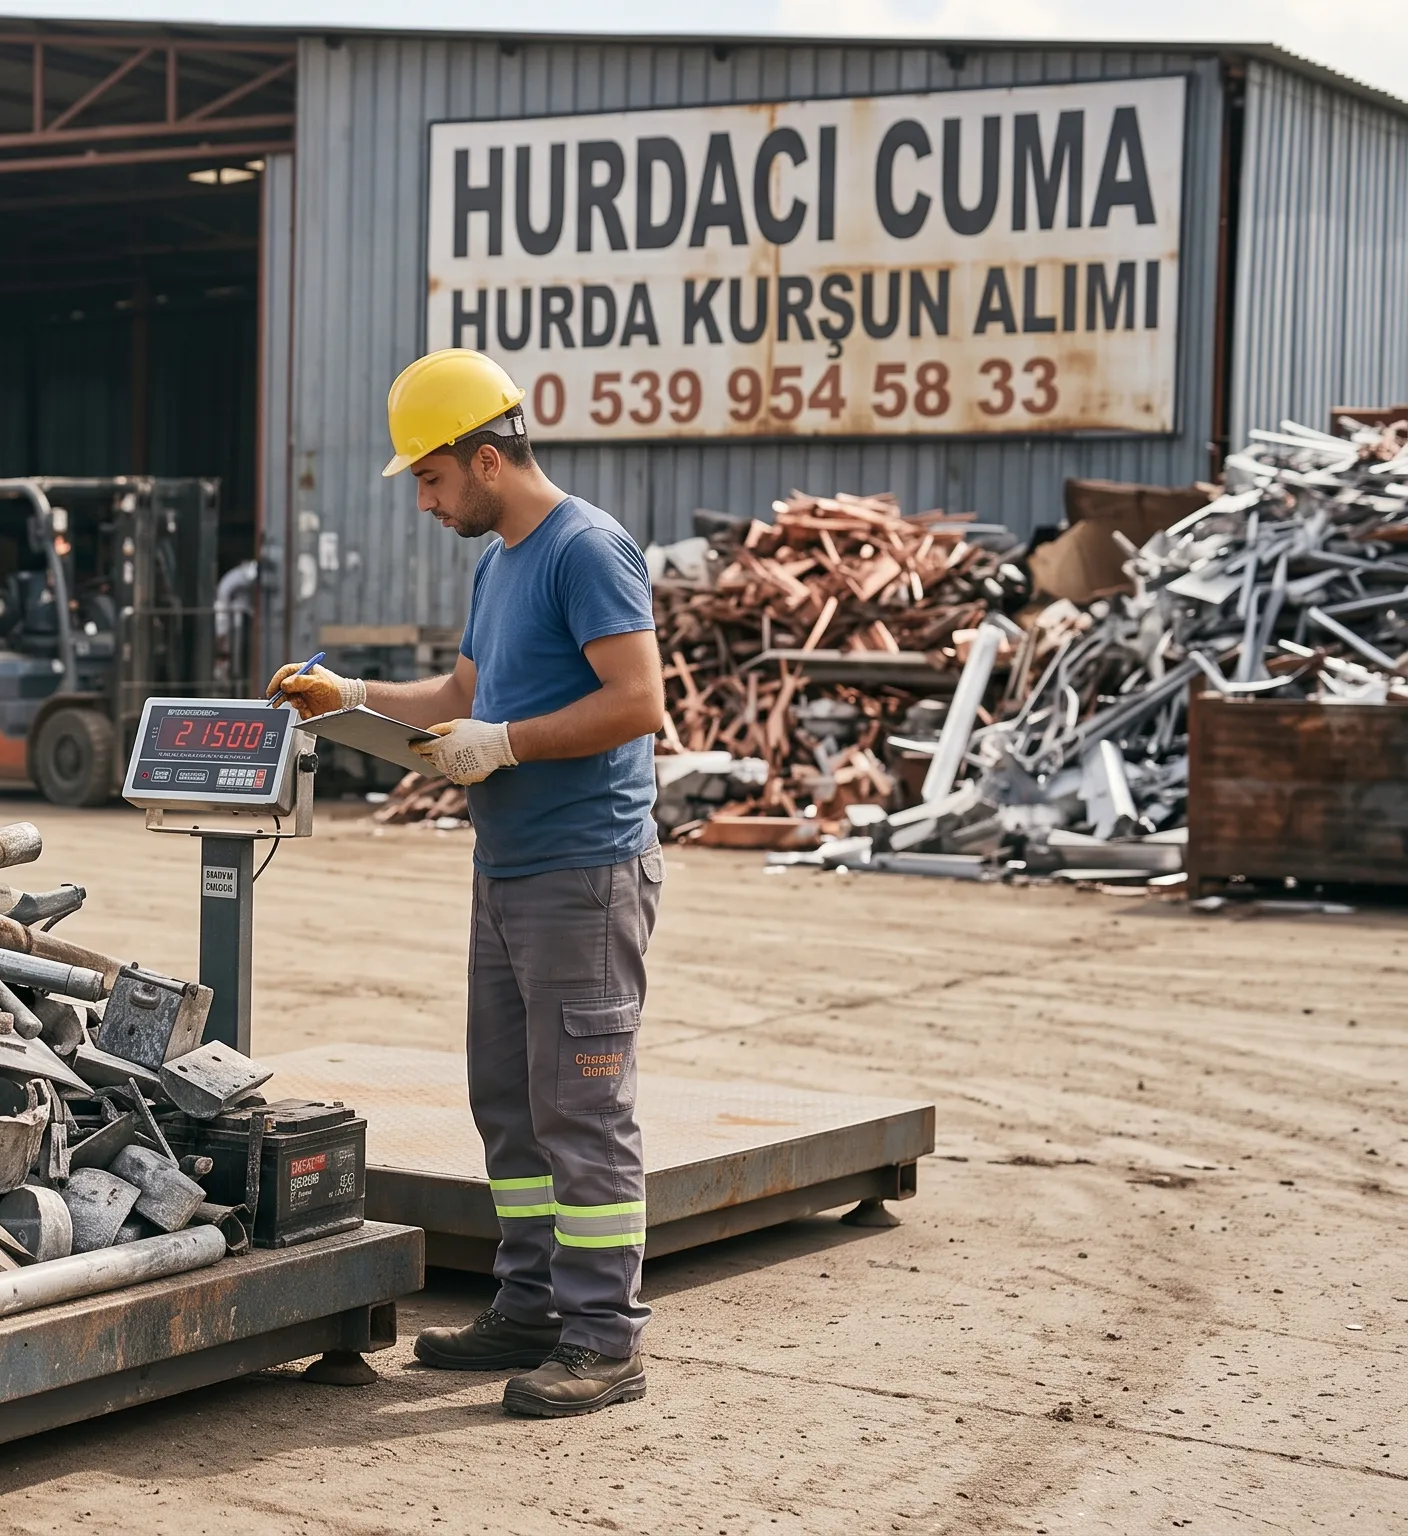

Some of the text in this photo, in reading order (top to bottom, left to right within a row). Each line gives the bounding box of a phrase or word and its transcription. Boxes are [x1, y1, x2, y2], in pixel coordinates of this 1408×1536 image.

[453, 105, 1157, 258] HURDACI CUMA
[451, 260, 1160, 359] HURDA KURŞUN ALIMI
[533, 357, 1059, 427] 0 539 954 58 33
[175, 721, 264, 749] 21500
